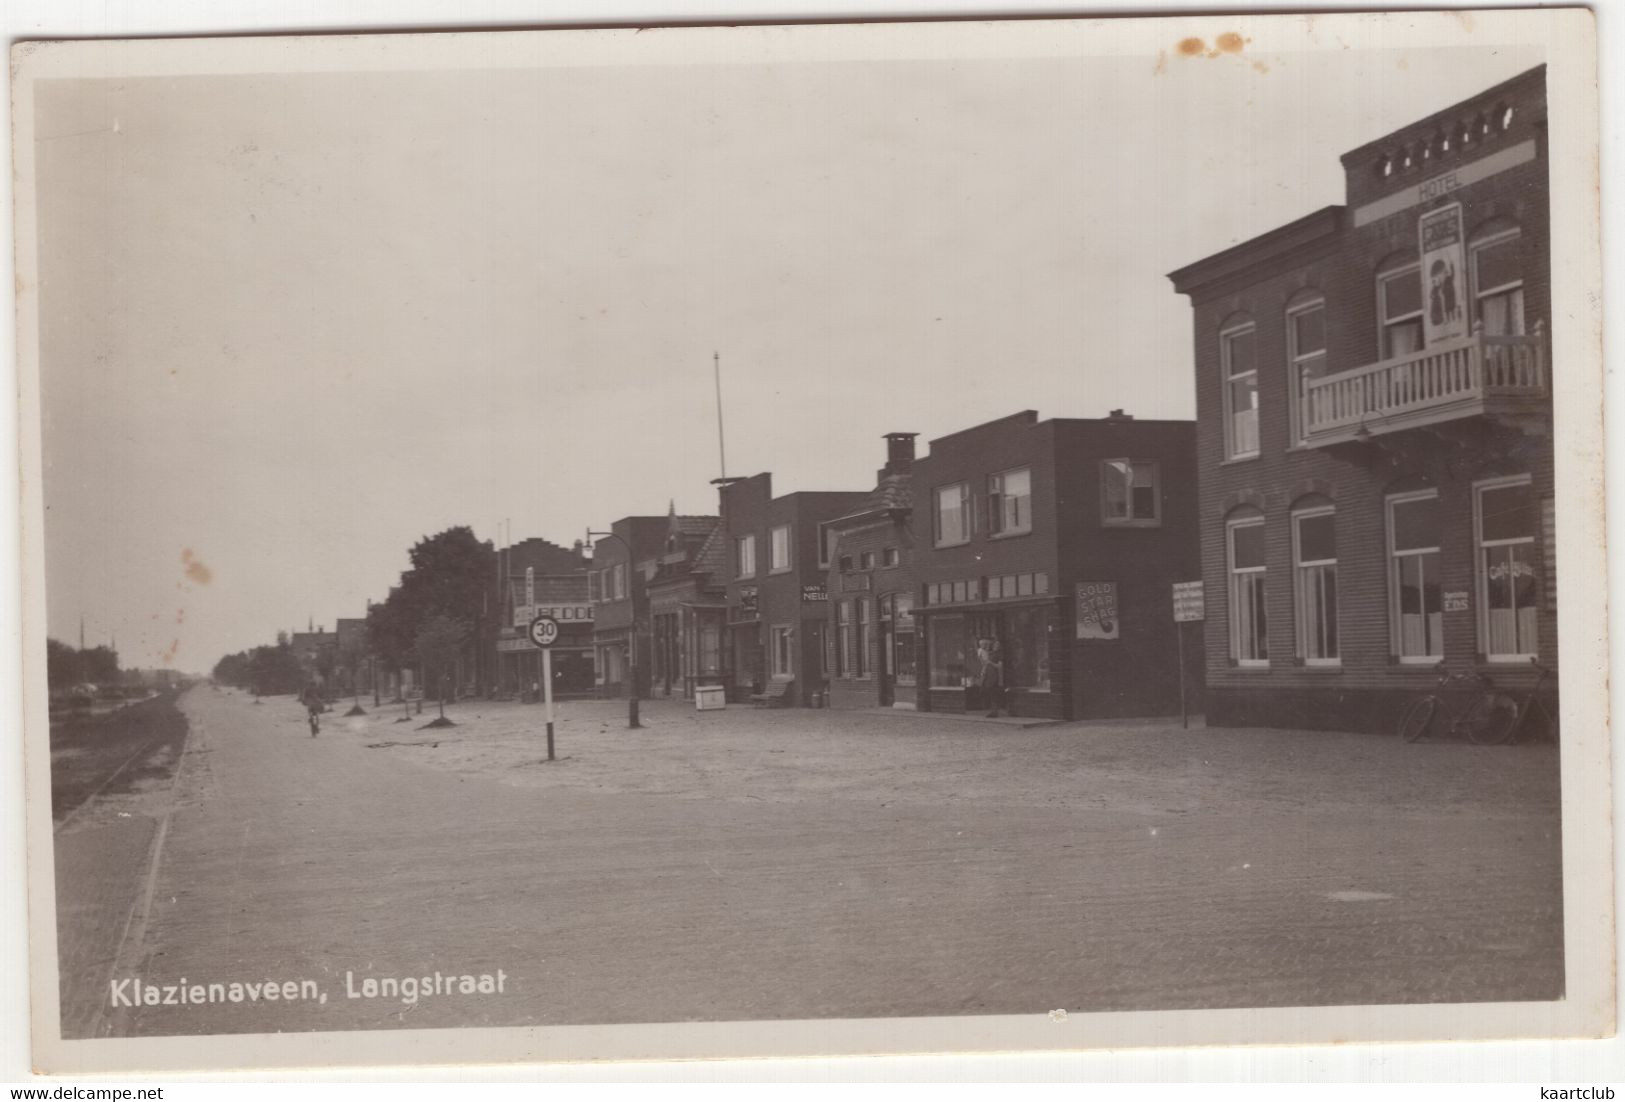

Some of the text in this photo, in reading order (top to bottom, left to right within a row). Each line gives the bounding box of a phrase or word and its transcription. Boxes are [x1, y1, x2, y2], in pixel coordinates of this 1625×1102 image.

[1418, 172, 1462, 201] HOTEL
[1078, 583, 1112, 599] GOLD
[1080, 595, 1113, 613] STAR
[1084, 607, 1115, 625] SHAG
[536, 622, 555, 636] 30
